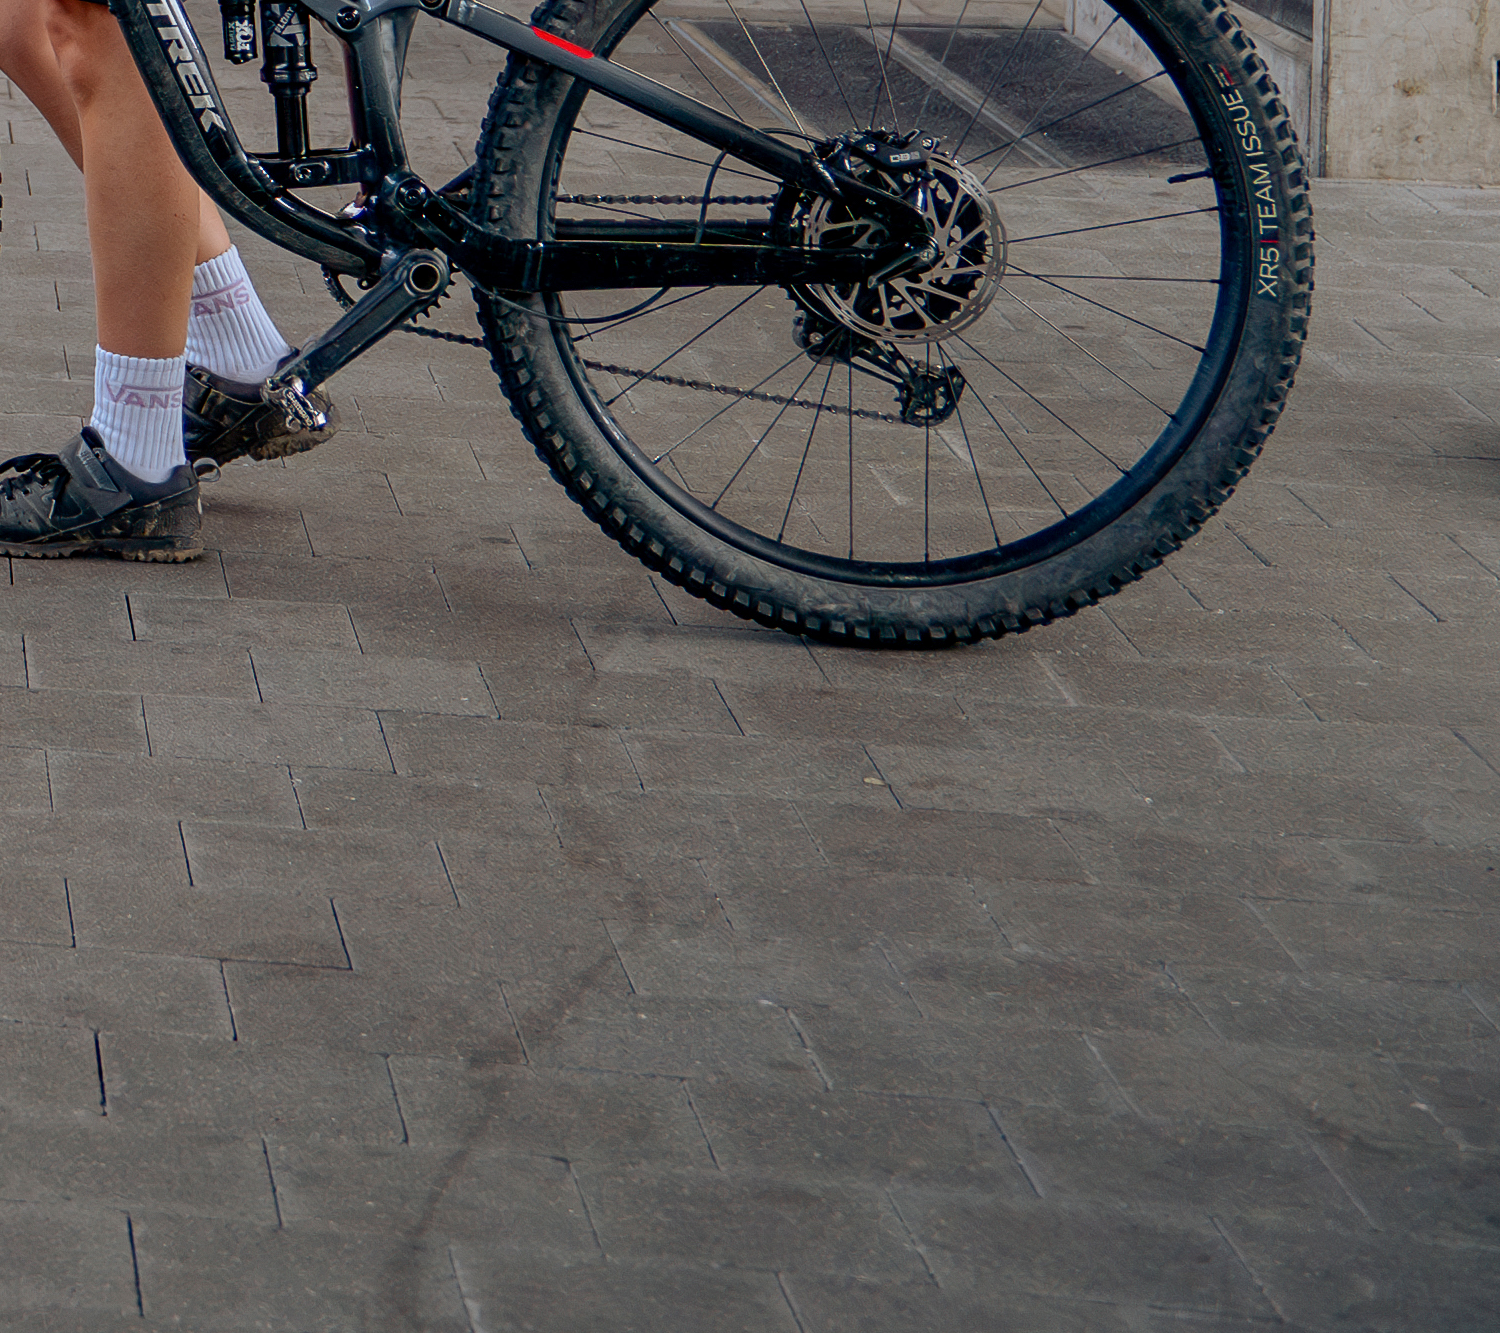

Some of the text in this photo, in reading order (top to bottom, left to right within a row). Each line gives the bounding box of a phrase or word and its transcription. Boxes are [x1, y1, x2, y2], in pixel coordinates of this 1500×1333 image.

[235, 20, 254, 51] FOX
[1220, 88, 1264, 157] ISSUE
[1249, 162, 1278, 235] TEAM
[1257, 246, 1280, 298] XR5
[191, 280, 251, 317] ANS
[106, 379, 184, 409] VANS
